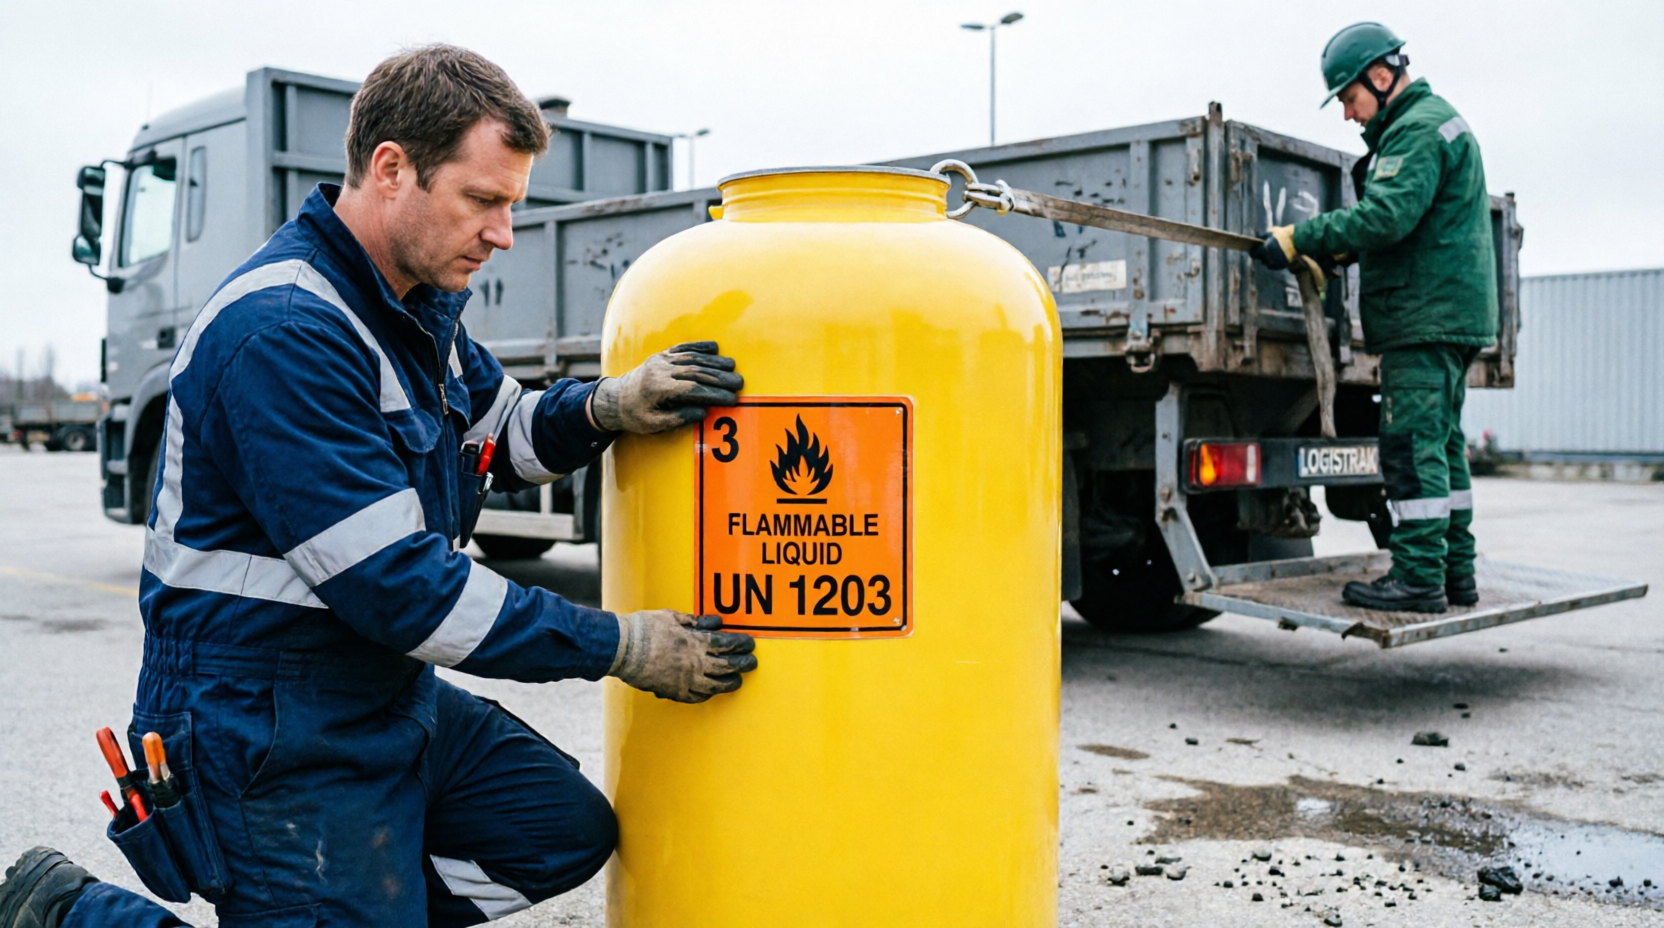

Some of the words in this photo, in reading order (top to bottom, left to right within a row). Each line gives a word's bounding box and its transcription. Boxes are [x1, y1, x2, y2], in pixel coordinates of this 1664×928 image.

[711, 416, 739, 462] 3
[728, 513, 879, 536] FLAMMABLE
[761, 542, 843, 566] LIQUID
[713, 573, 773, 615] UN
[789, 574, 892, 616] 1203
